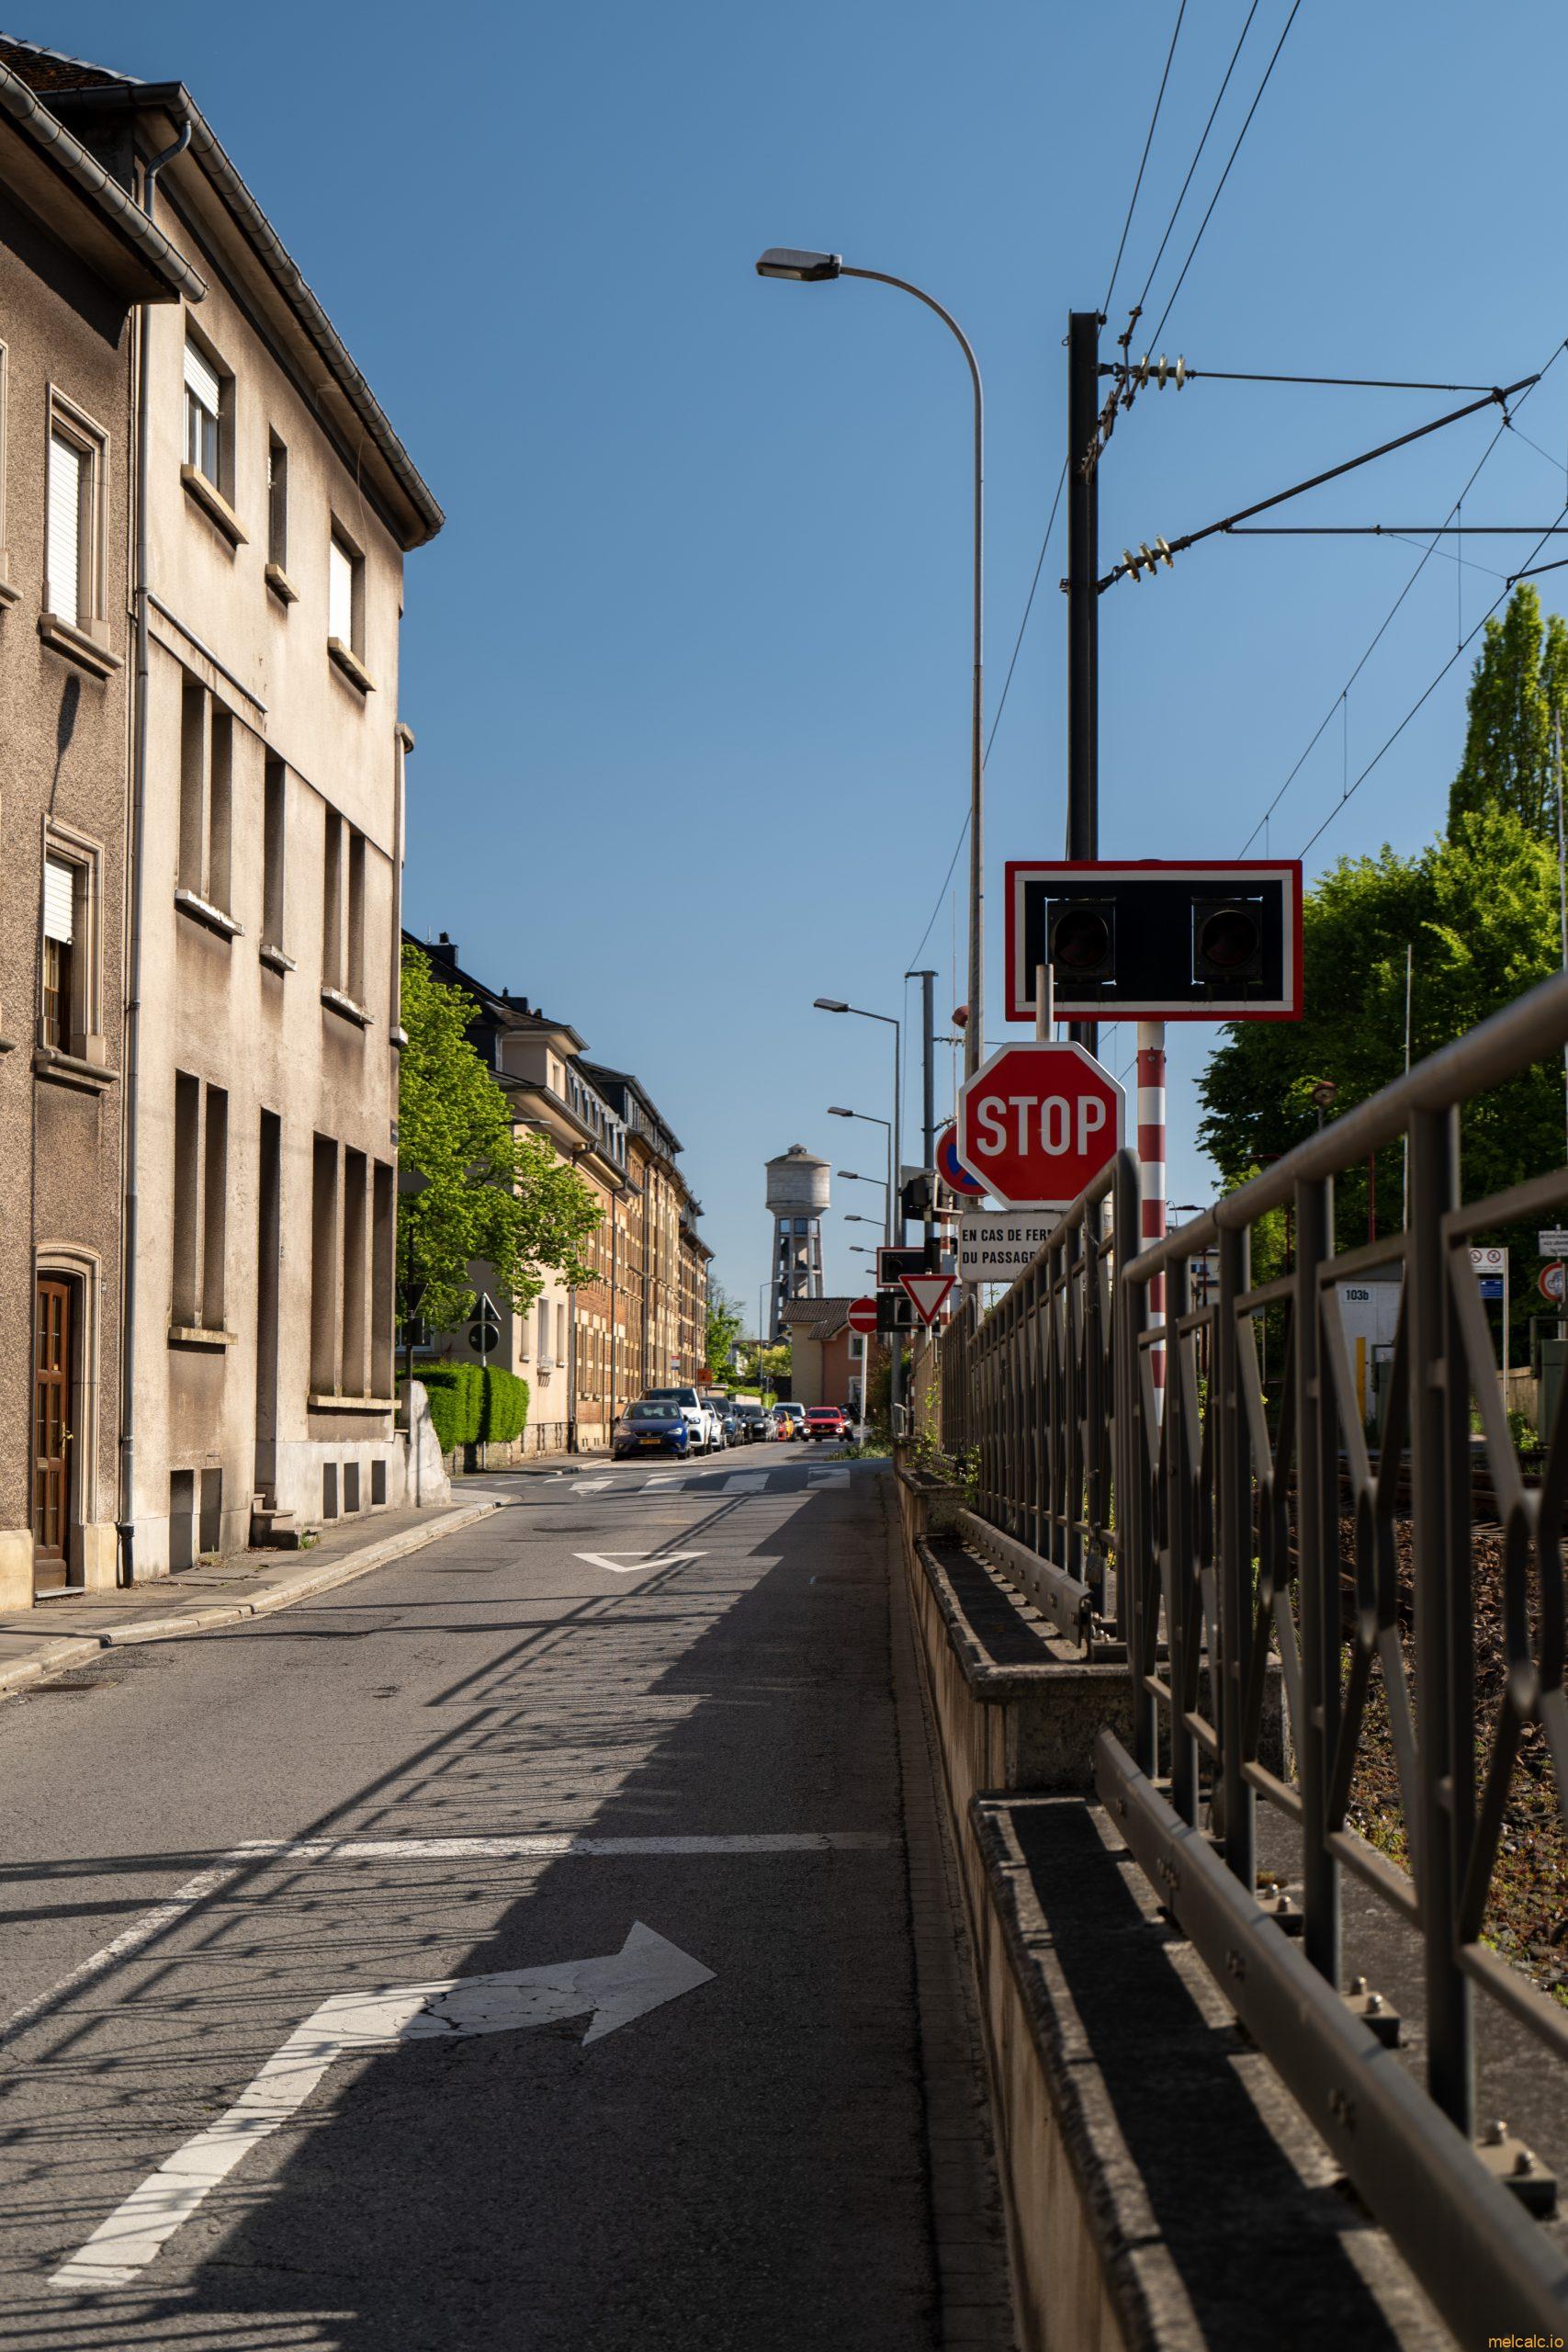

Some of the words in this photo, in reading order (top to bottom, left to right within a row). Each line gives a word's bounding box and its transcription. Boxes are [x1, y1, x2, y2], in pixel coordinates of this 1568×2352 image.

[976, 1095, 1106, 1157] STOP
[962, 1229, 976, 1241] EN
[981, 1229, 1004, 1241] CAS
[1008, 1229, 1021, 1241] DE
[963, 1251, 977, 1263] DU
[1346, 1289, 1369, 1300] 103b
